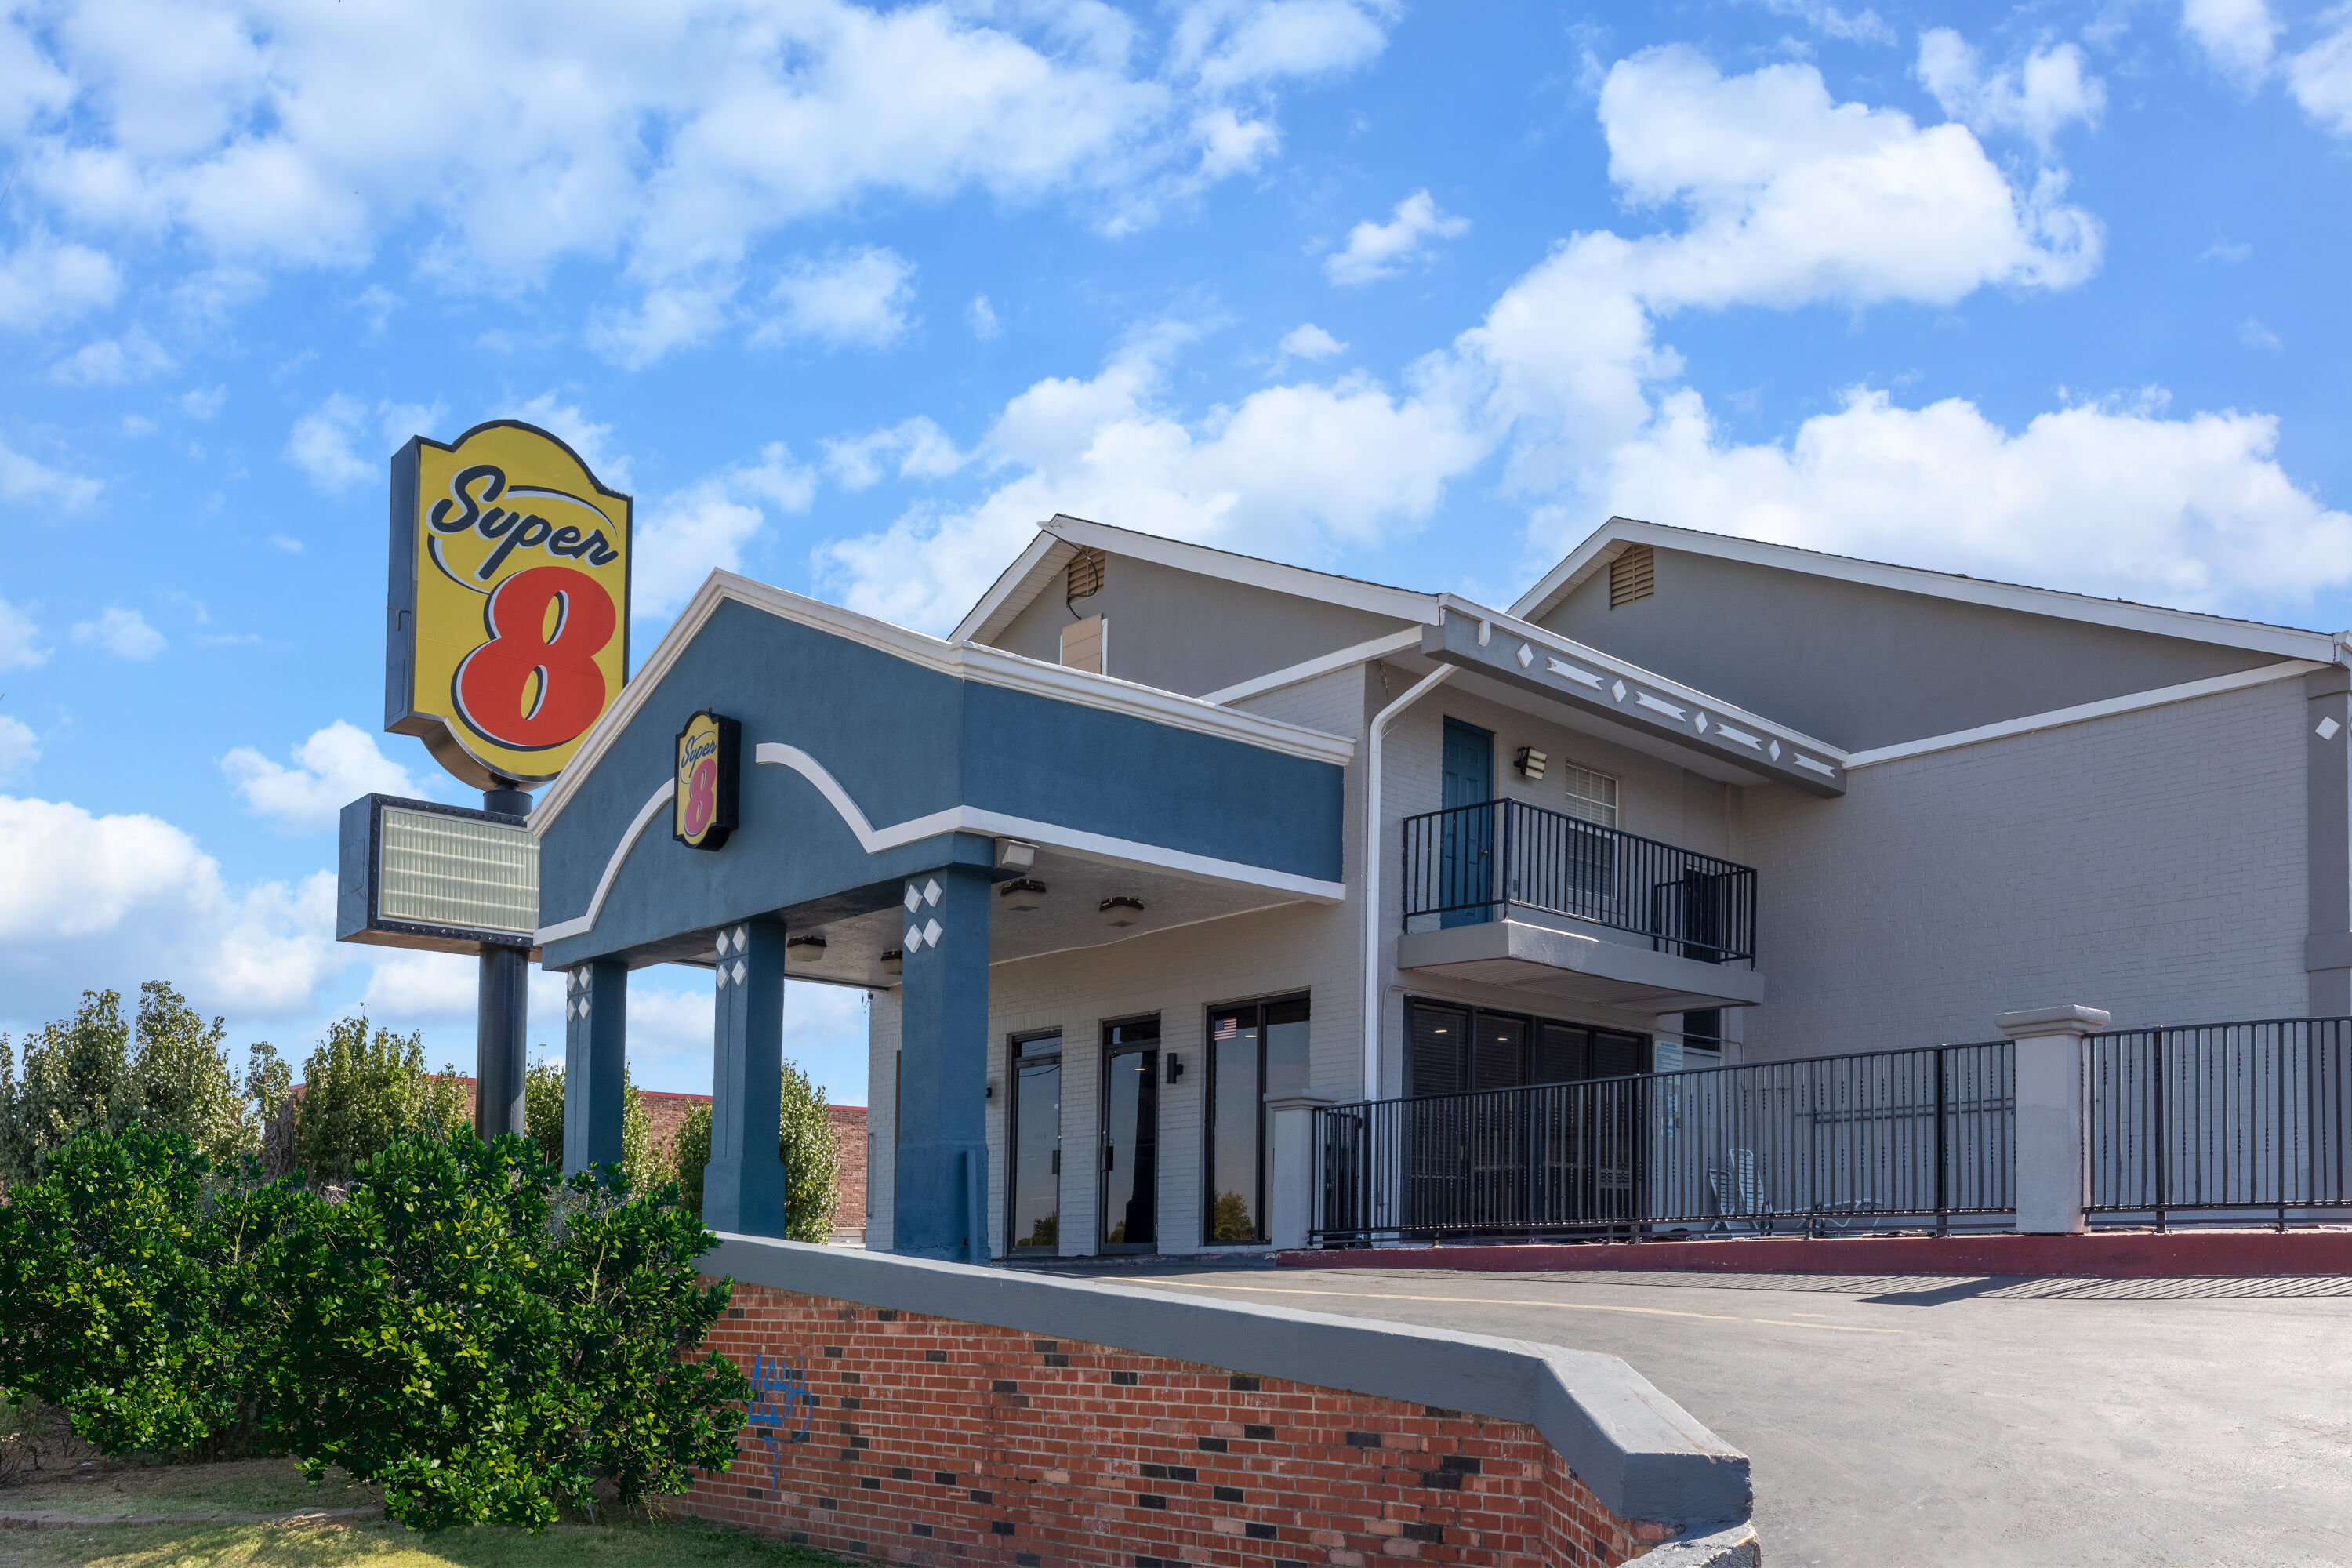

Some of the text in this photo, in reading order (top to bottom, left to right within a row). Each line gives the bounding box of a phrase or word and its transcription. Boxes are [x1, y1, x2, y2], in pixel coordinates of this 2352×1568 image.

[426, 464, 619, 581] Super
[451, 566, 617, 752] 8
[681, 735, 717, 779] Super
[684, 758, 717, 837] 8
